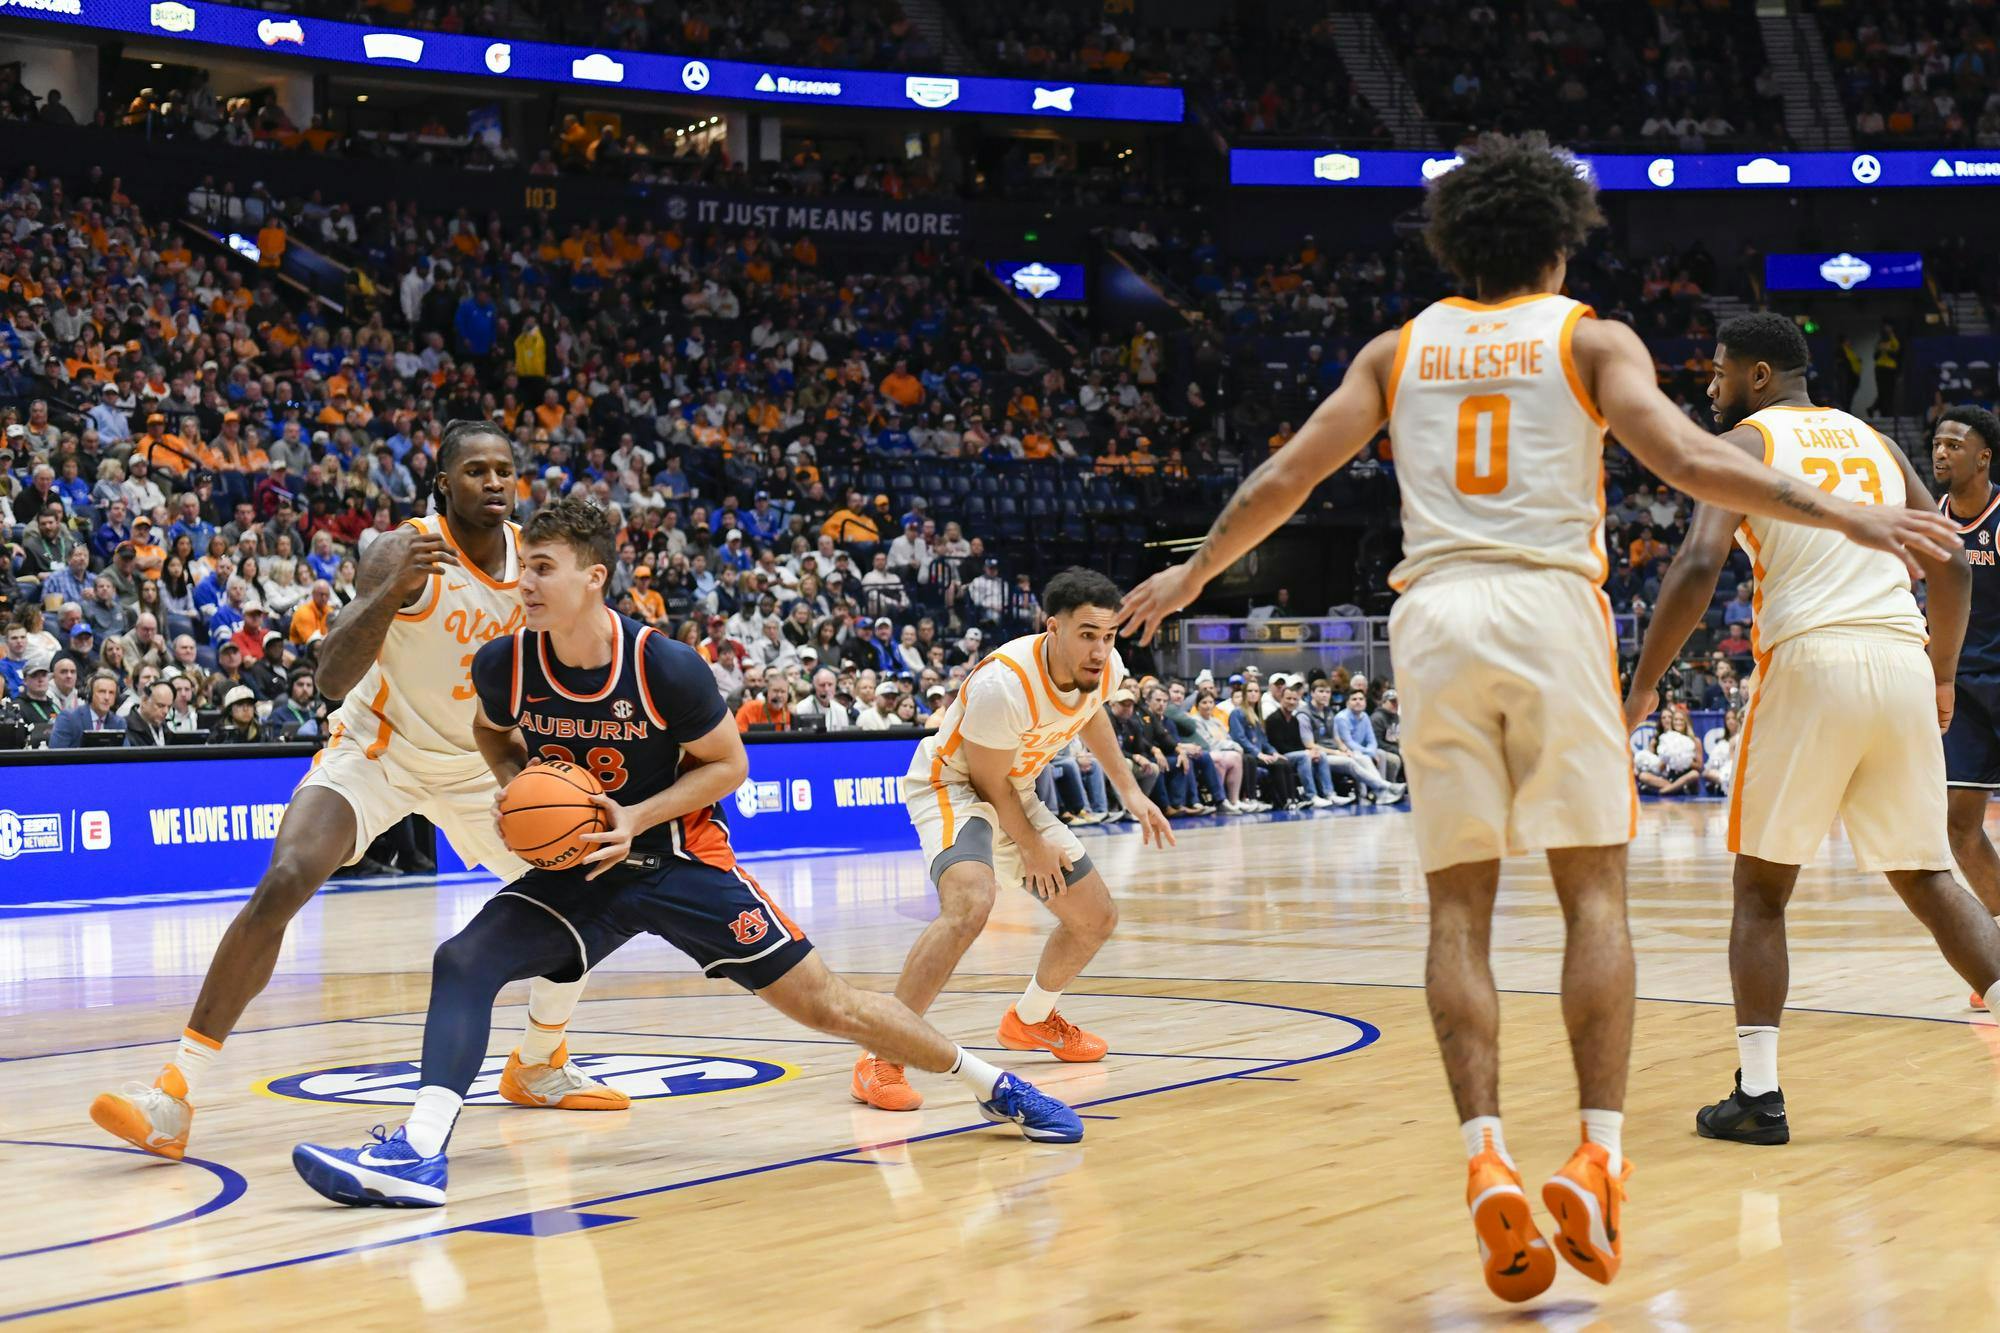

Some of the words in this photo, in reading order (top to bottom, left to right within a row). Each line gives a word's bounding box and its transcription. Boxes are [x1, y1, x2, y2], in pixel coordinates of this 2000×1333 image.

[525, 187, 557, 210] 103
[698, 201, 719, 223] IT
[723, 202, 780, 228] JUST
[787, 206, 873, 233] MEANS
[1418, 340, 1545, 381] GILLESPIE
[1455, 393, 1511, 496] 0
[1793, 427, 1860, 449] CAREY
[1800, 457, 1884, 507] 23
[1978, 530, 1990, 545] SEC
[444, 603, 527, 644] Vol
[518, 710, 649, 741] AUBURN
[612, 699, 634, 720] SEC
[833, 778, 855, 808] WE
[855, 776, 884, 807] LOVE
[884, 776, 896, 805] IT
[150, 807, 182, 845] WE
[184, 805, 229, 842] LOVE
[231, 804, 248, 841] IT
[251, 803, 290, 840] HER
[23, 836, 60, 849] NETWORK
